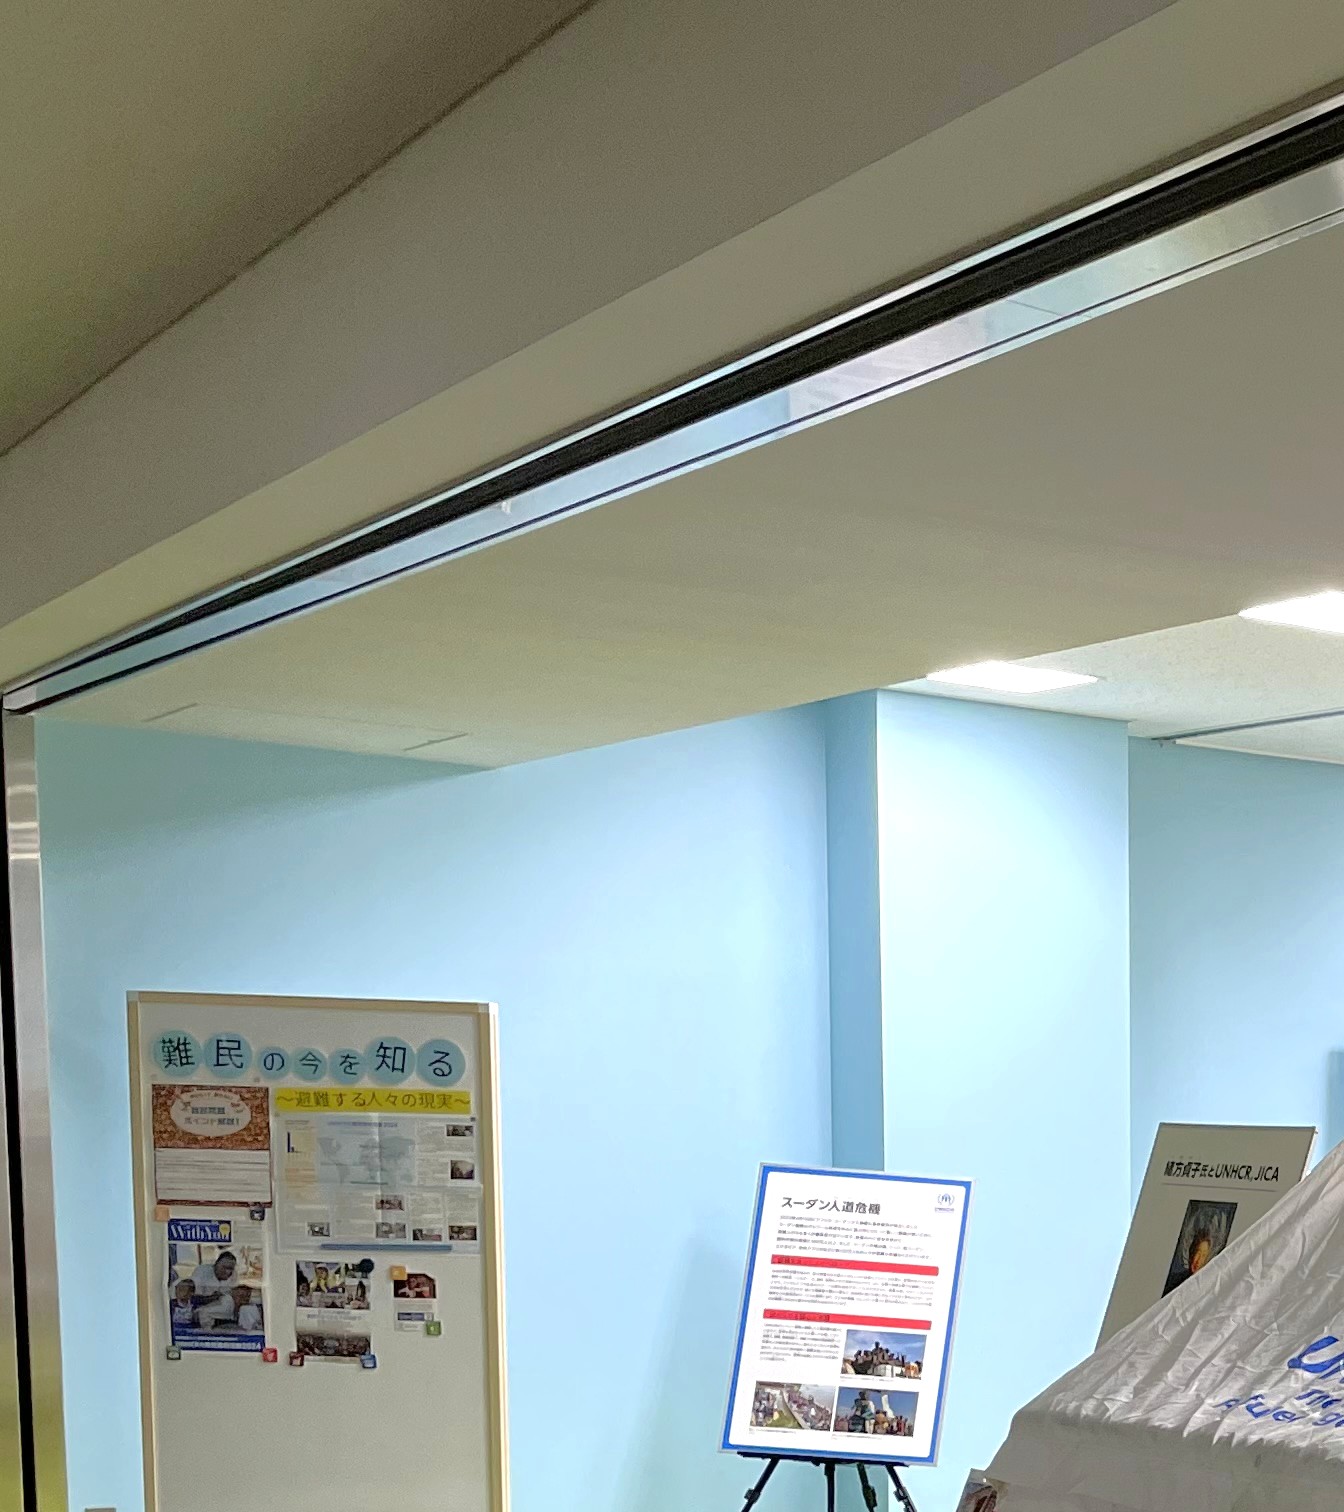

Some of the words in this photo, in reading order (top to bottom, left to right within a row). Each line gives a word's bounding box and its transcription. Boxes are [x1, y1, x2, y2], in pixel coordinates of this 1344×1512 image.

[161, 1036, 453, 1078] 難民の今を知る
[781, 1196, 882, 1216] スーダン人道危機
